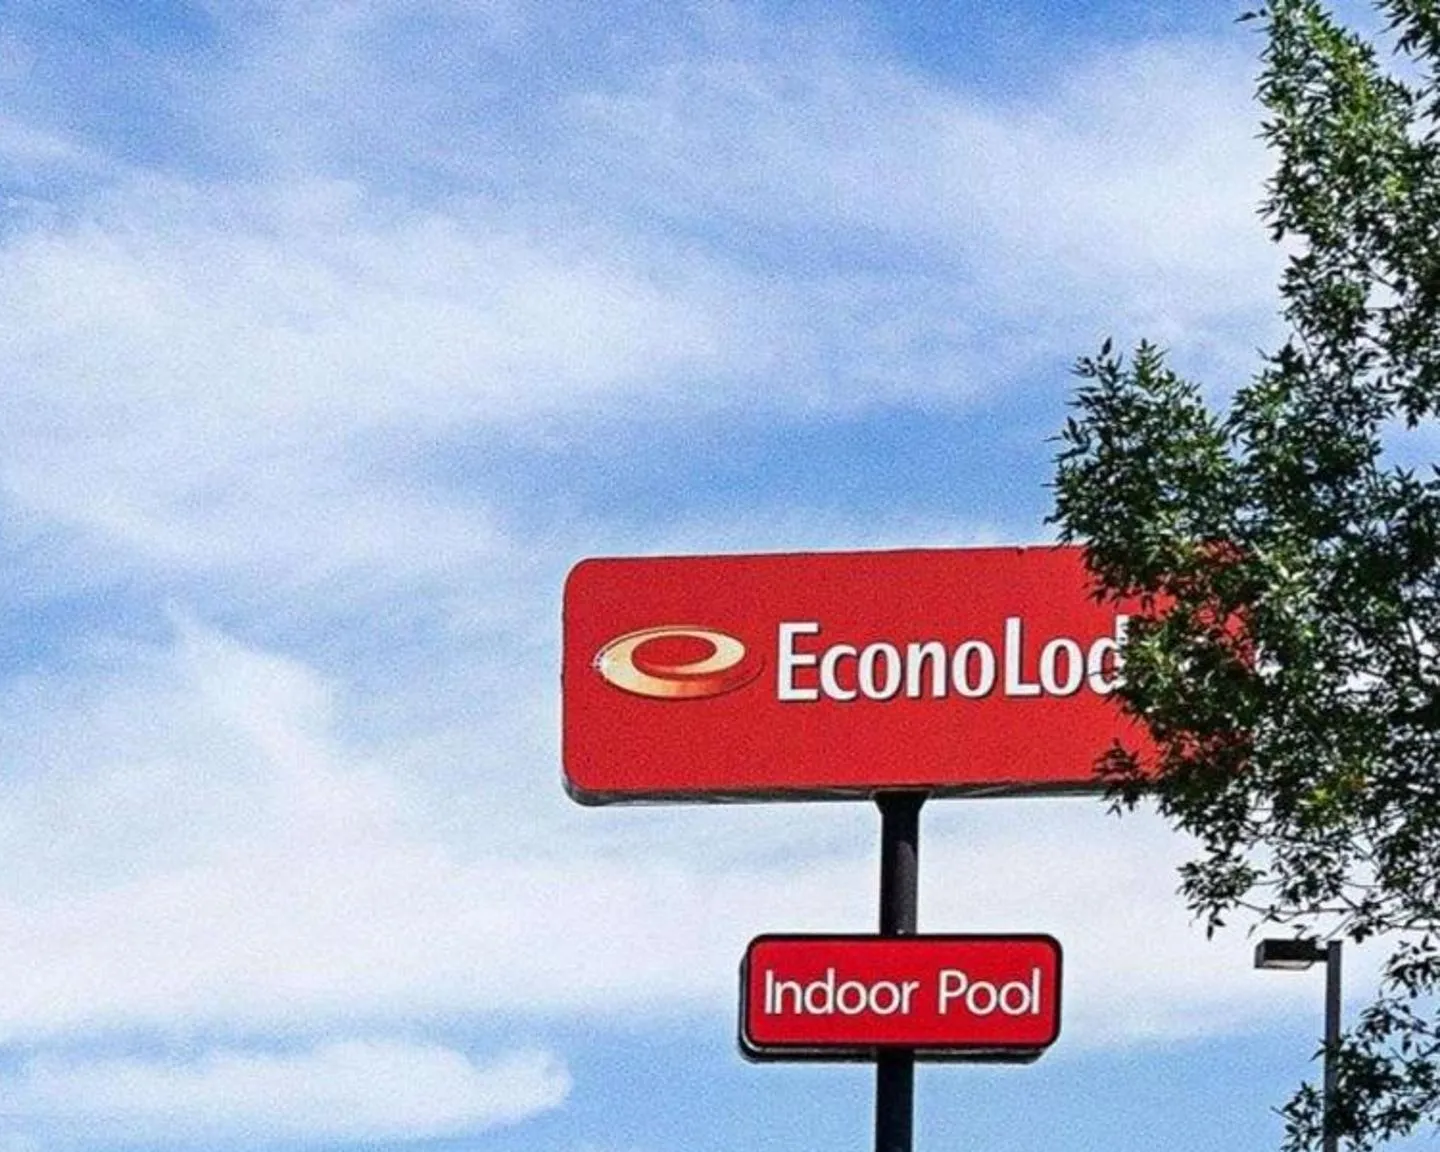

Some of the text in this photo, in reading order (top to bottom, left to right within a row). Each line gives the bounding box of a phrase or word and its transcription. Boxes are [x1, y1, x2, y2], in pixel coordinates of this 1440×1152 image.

[776, 614, 1128, 701] EconoLod
[764, 967, 1041, 1016] Indoor Pool
